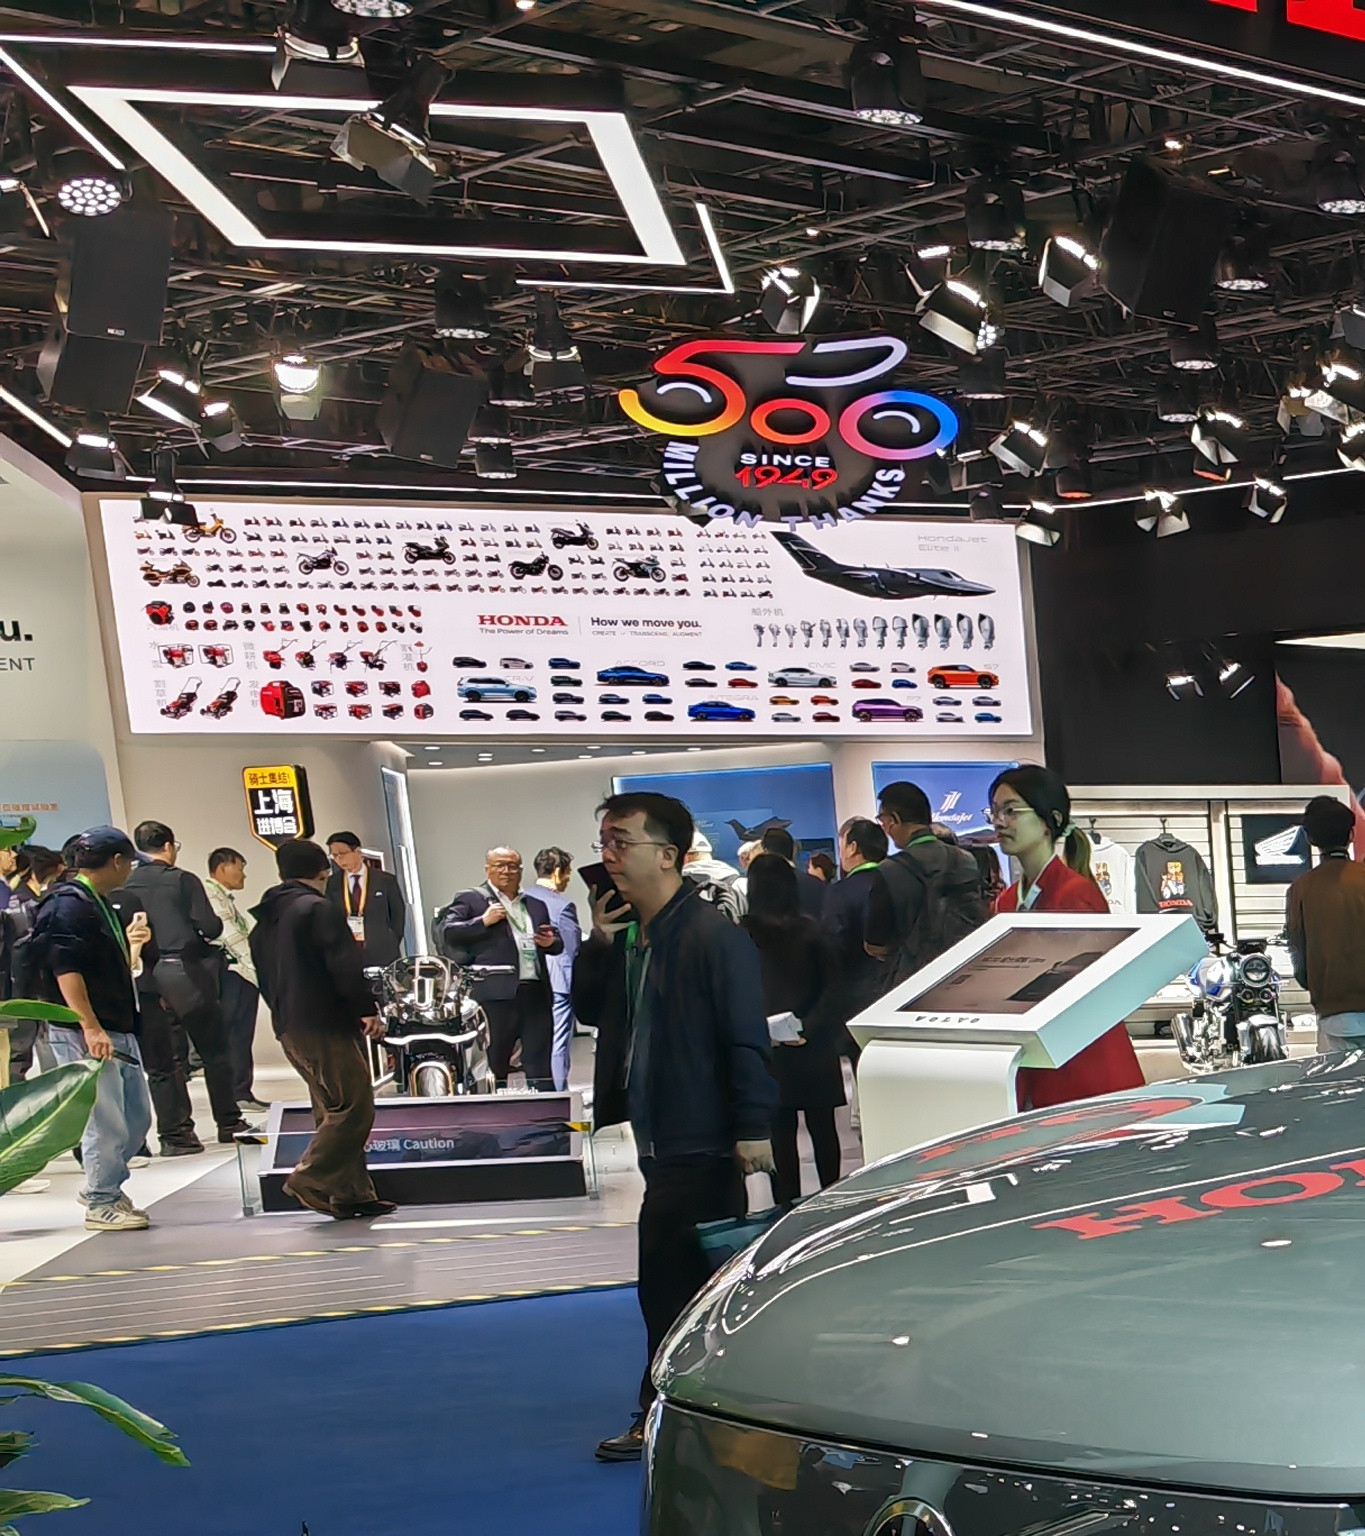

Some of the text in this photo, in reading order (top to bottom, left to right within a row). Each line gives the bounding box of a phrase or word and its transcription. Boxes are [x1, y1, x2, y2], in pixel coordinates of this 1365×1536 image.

[740, 452, 831, 468] SINCE
[734, 465, 838, 491] 1949
[663, 440, 906, 532] MILLION THANKS
[917, 543, 950, 552] Elite
[477, 615, 703, 630] HONDA How we move you.
[536, 628, 569, 636] Dreams
[254, 789, 294, 815] 上海
[403, 1137, 455, 1150] Caution
